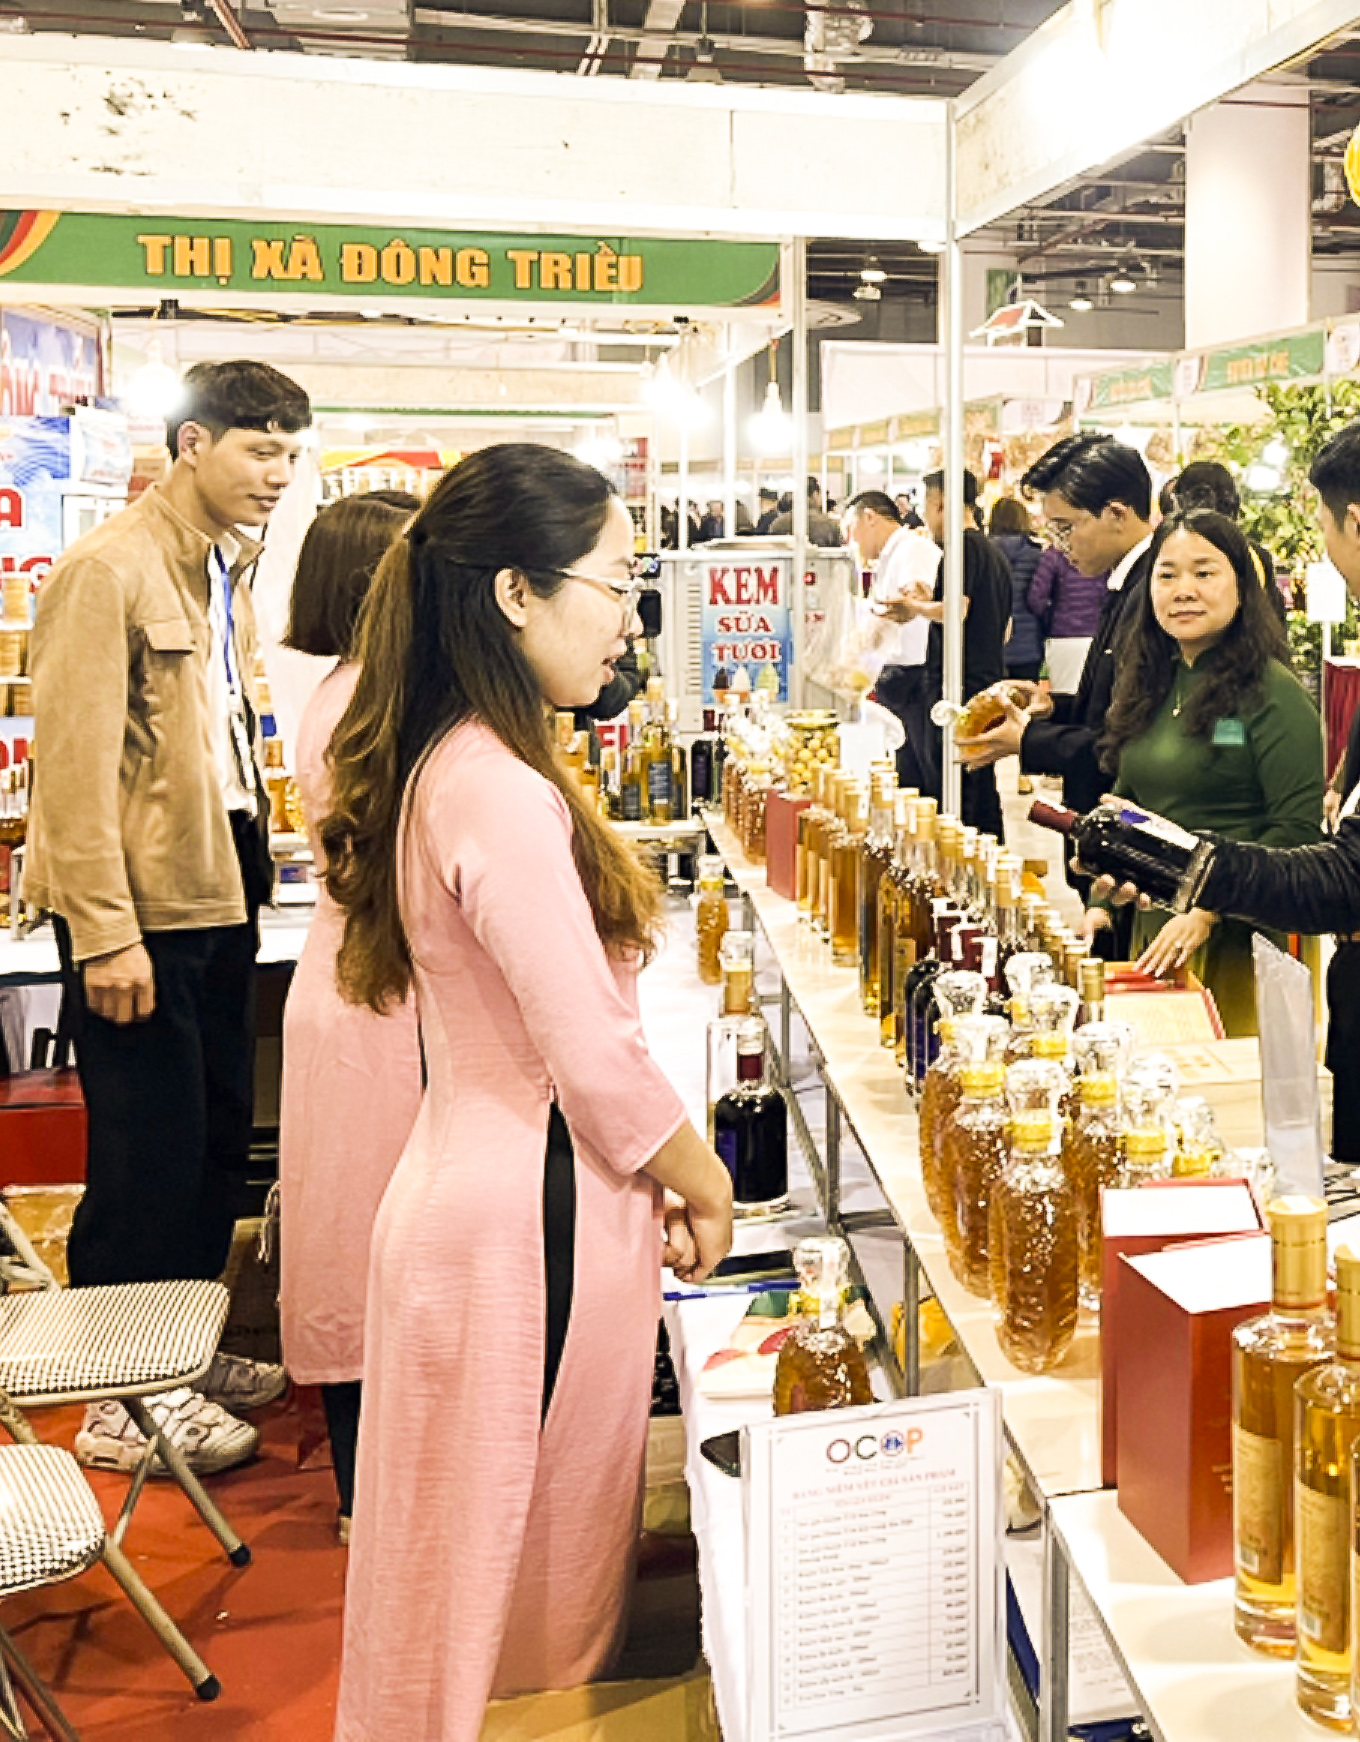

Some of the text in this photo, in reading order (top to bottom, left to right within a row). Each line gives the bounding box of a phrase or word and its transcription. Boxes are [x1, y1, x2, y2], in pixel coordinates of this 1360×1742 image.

[137, 234, 644, 292] THỊ XÃ ĐÔNG TRIỀU
[708, 566, 779, 606] KEM
[718, 610, 772, 634] SỮA
[826, 1427, 924, 1465] OCOP
